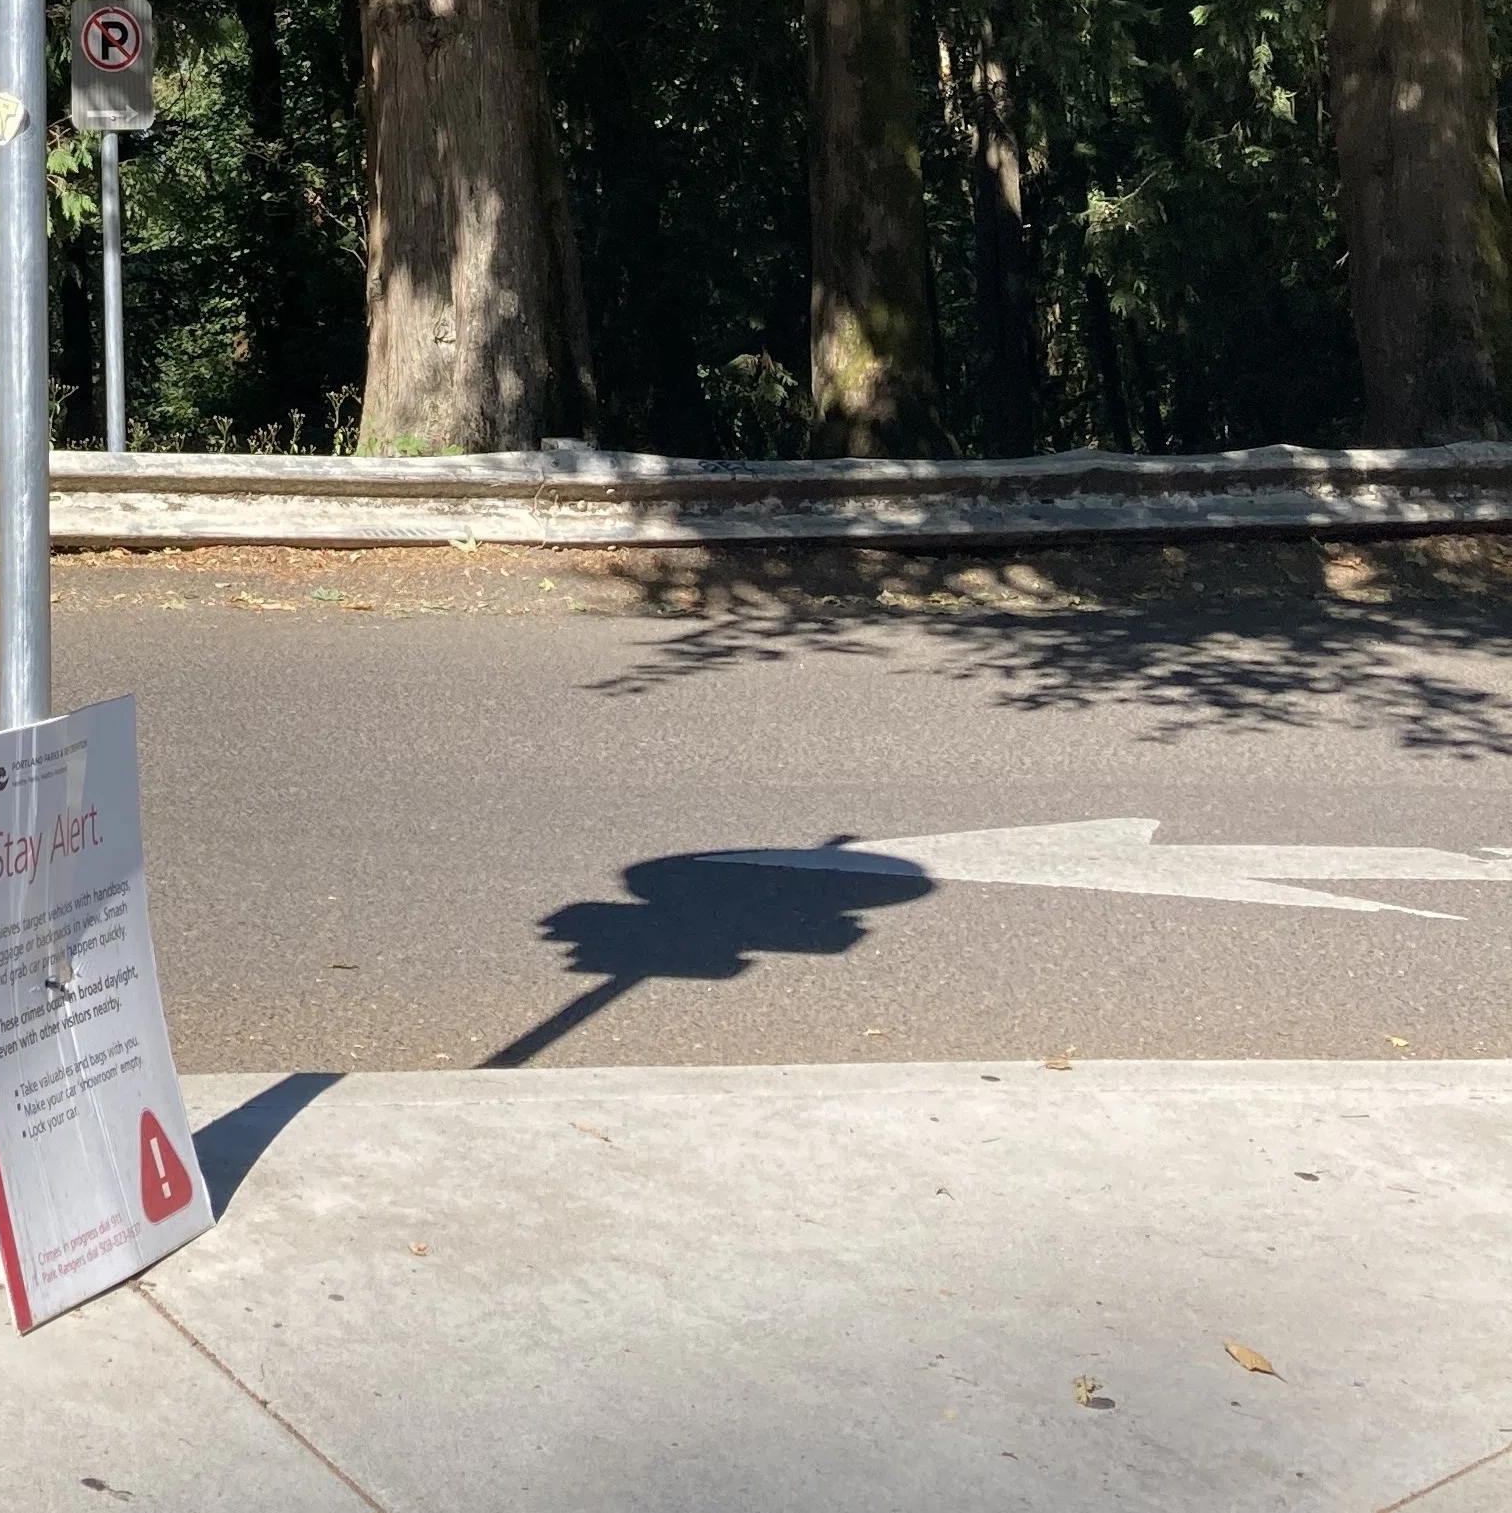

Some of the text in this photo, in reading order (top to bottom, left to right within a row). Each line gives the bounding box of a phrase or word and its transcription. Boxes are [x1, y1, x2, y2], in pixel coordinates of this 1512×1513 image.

[101, 21, 129, 60] P
[11, 755, 44, 771] PORTLAND
[49, 804, 104, 864] Alert.
[22, 911, 47, 932] target
[74, 893, 92, 910] with
[25, 941, 34, 953] or
[73, 919, 81, 933] in
[103, 900, 129, 921] Smash
[9, 965, 28, 986] grab
[29, 959, 41, 974] car
[66, 935, 97, 958] happen
[20, 1002, 45, 1025] crimes
[68, 990, 77, 1004] in
[78, 976, 103, 1001] broad
[104, 964, 139, 991] daylight,
[20, 1028, 39, 1050] with
[39, 1019, 61, 1041] other
[61, 1007, 92, 1030] visitors
[93, 996, 123, 1018] nearby.
[20, 1078, 38, 1097] Take
[39, 1065, 74, 1088] valuables
[74, 1057, 90, 1074] and
[90, 1047, 107, 1067] bags
[107, 1039, 124, 1058] with
[23, 1097, 46, 1117] Make
[47, 1088, 65, 1111] your
[65, 1084, 77, 1099] car
[28, 1120, 47, 1139] Lock
[47, 1111, 65, 1134] your
[38, 1247, 62, 1266] Crimes
